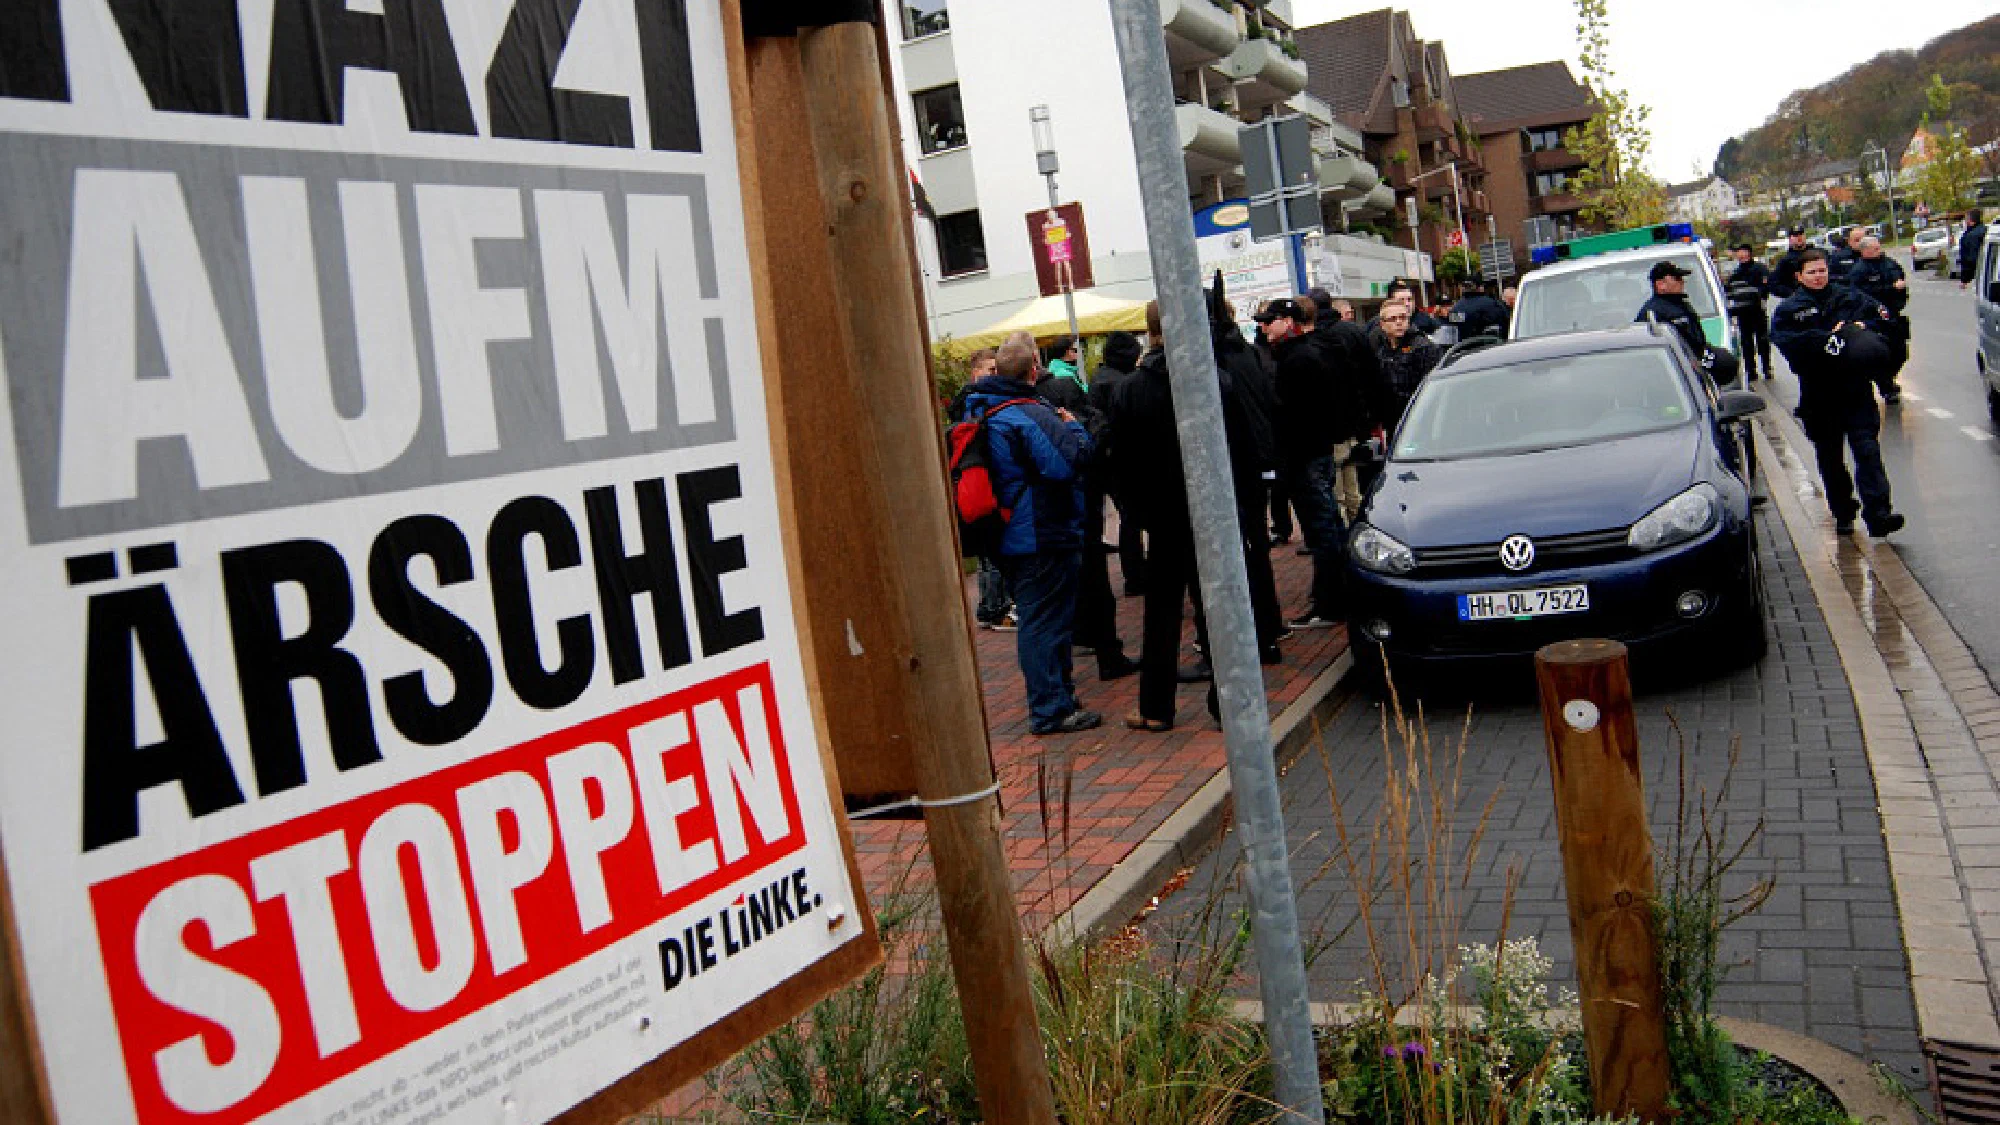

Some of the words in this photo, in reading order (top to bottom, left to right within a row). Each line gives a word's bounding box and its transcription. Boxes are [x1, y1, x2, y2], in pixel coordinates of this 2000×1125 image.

[65, 463, 766, 854] ÄRSCHE
[1469, 596, 1494, 617] HH
[1536, 587, 1588, 611] 7522
[134, 682, 790, 1115] STOPPEN
[658, 916, 718, 992] DIE
